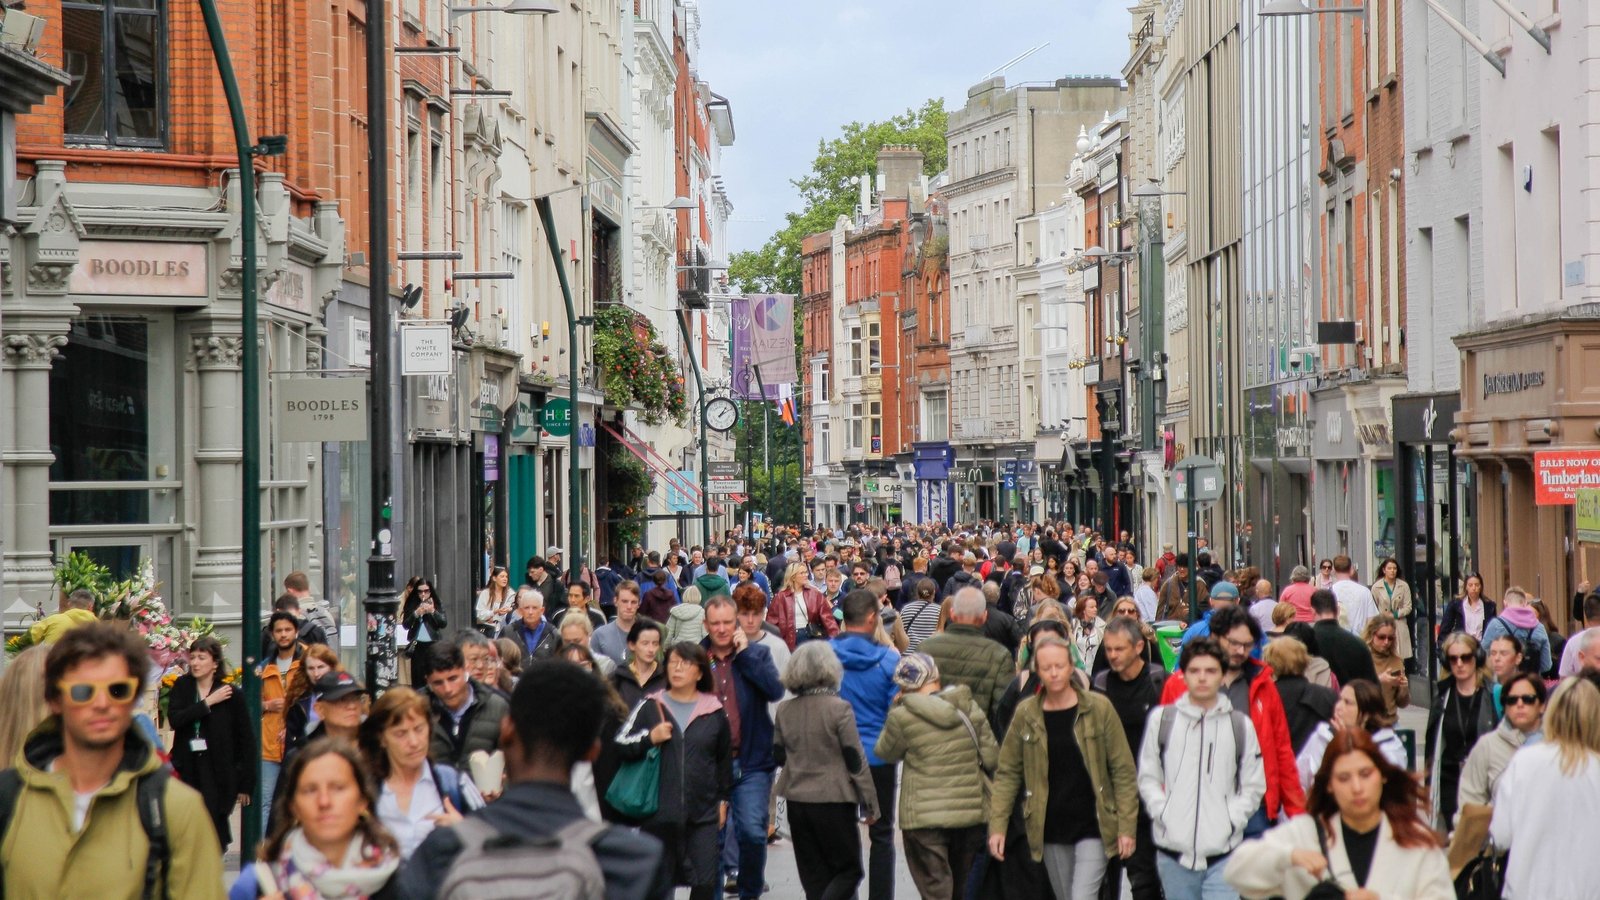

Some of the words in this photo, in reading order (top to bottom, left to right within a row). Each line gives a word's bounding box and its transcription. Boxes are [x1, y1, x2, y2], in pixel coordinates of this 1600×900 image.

[89, 258, 189, 276] BOODLES
[287, 400, 359, 411] BOODLES
[1540, 459, 1565, 468] SALE
[1566, 458, 1589, 467] NOW
[1591, 458, 1600, 466] O
[1540, 469, 1600, 485] Timberlan
